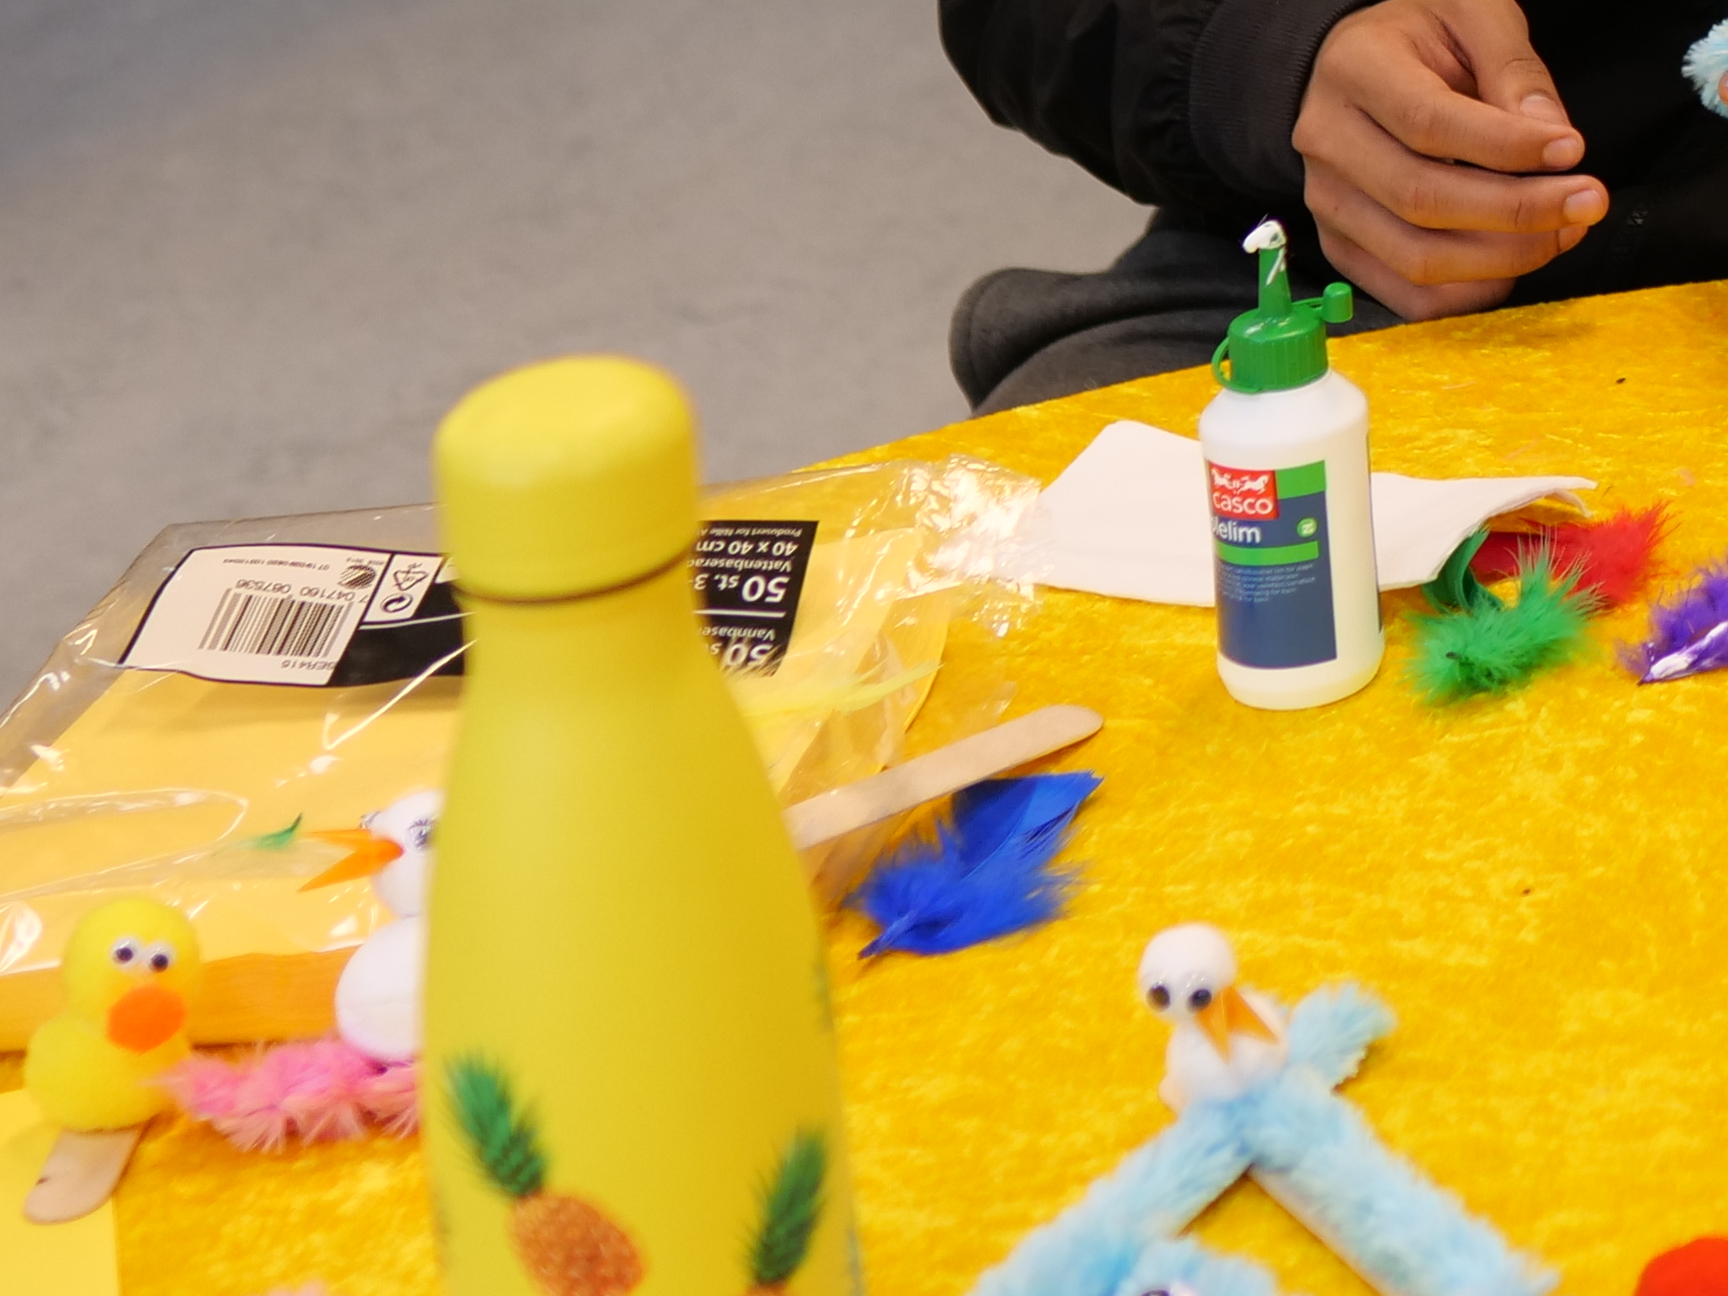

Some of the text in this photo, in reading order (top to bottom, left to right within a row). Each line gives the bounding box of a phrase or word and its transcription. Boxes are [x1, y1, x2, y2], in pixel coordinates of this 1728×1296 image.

[1212, 491, 1274, 515] casco
[696, 540, 799, 556] 40 x 40 cm
[713, 574, 741, 591] st.
[742, 575, 790, 602] 50
[701, 626, 776, 641] Vannbase
[708, 642, 723, 655] s
